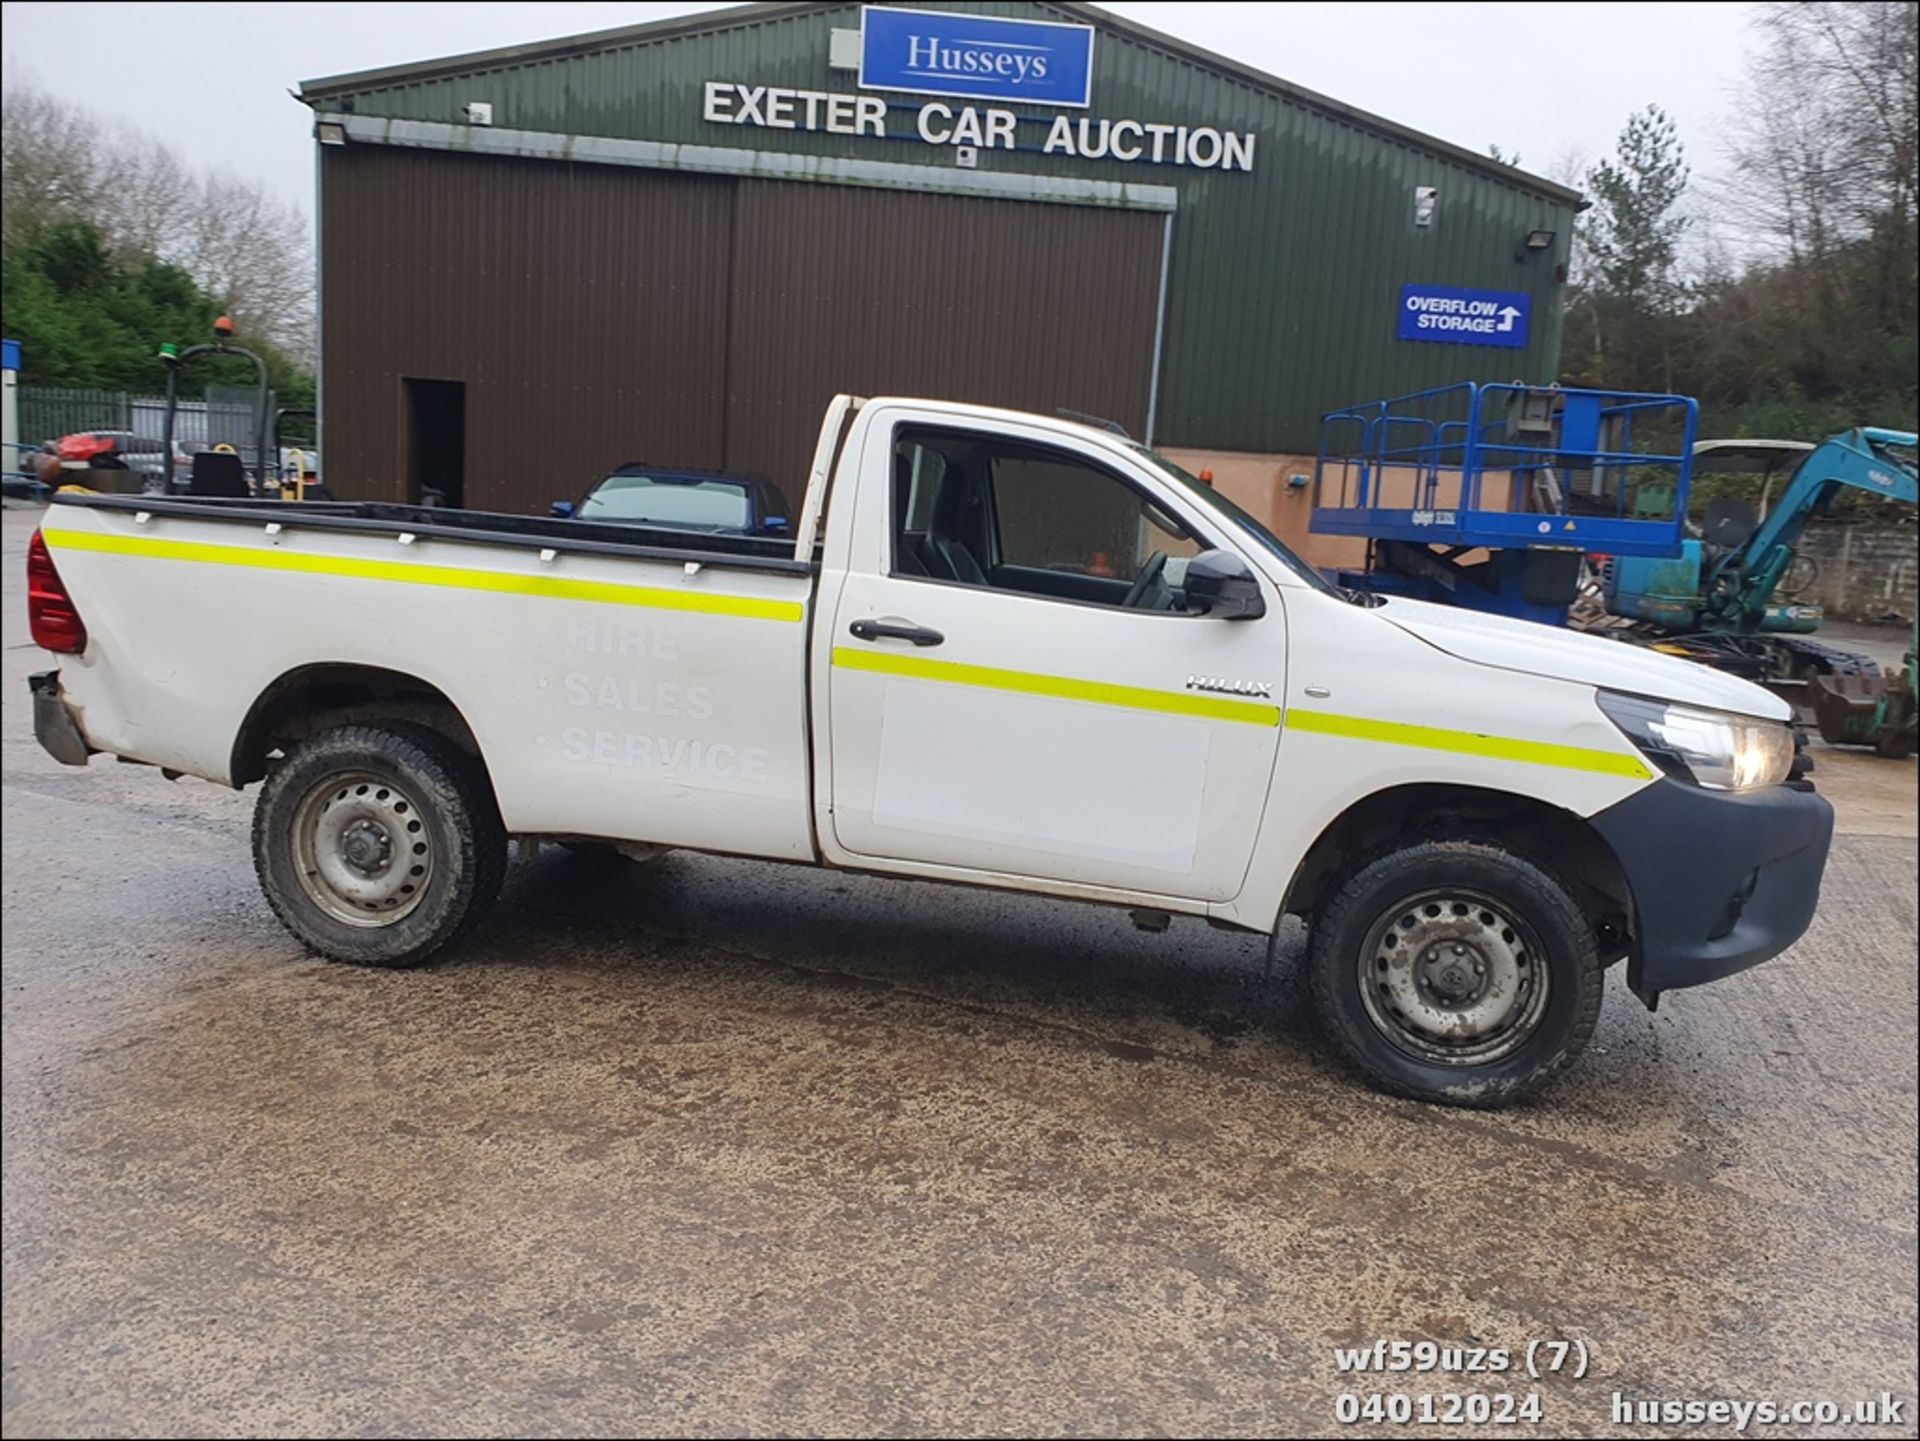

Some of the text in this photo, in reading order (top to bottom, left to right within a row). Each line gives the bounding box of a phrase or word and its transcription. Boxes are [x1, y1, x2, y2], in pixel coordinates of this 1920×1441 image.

[907, 36, 1047, 83] Husseys
[703, 81, 1256, 172] EXETER CAR AUCTION
[1406, 296, 1498, 316] OVERFLOW
[1417, 314, 1496, 333] STORAGE
[570, 617, 678, 661] HIRE
[565, 672, 715, 720] SALES
[1186, 674, 1272, 698] HILUX
[560, 726, 768, 781] SERVICE
